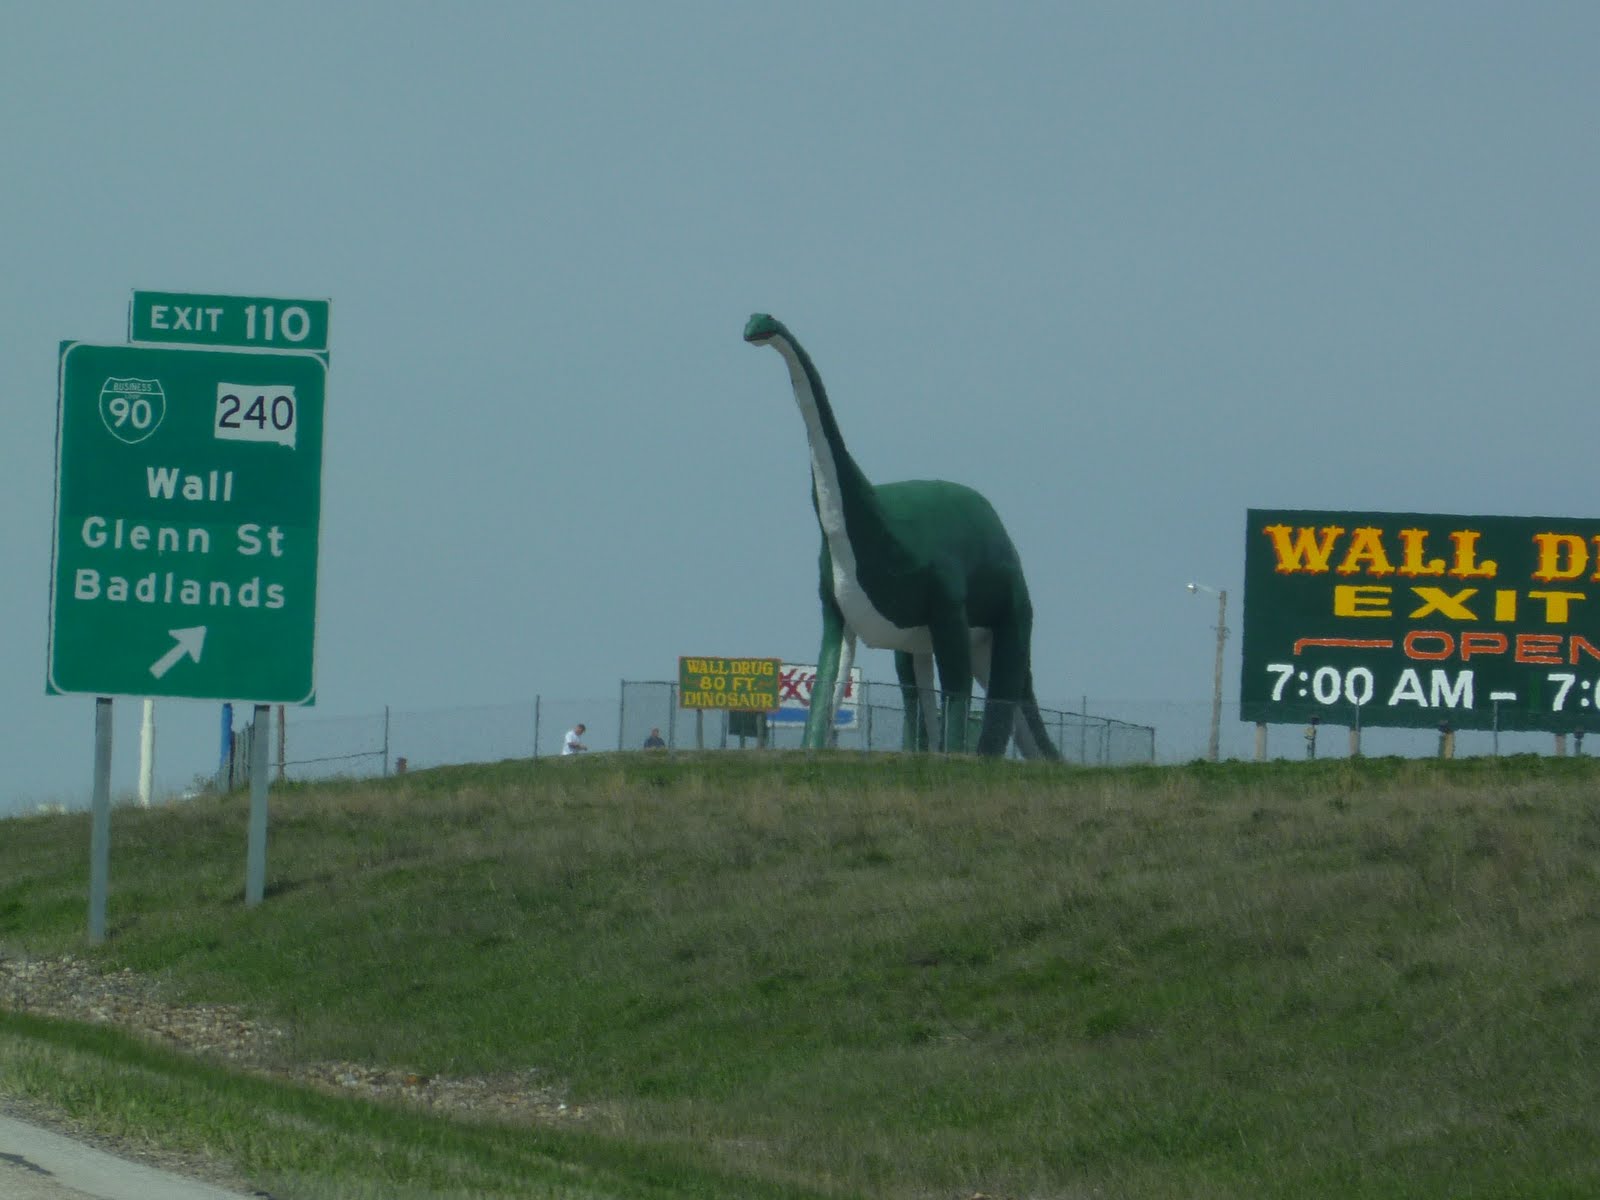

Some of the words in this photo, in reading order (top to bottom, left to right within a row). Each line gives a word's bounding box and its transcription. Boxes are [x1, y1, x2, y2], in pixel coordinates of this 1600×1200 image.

[151, 305, 223, 332] EXIT
[245, 305, 310, 342] 110
[113, 382, 152, 392] BUSINESS
[109, 398, 152, 429] 90
[218, 394, 294, 430] 240
[147, 467, 233, 501] Wall
[82, 516, 210, 554] Glenn
[237, 523, 284, 557] St
[1263, 524, 1497, 579] WALL
[1531, 532, 1600, 582] D
[74, 569, 285, 609] Badlands
[1334, 585, 1586, 623] EXIT
[687, 659, 729, 674] WALL
[731, 660, 774, 675] DRUG
[700, 676, 726, 690] 80
[732, 677, 758, 691] FT.
[684, 691, 773, 708] DINOSAUR
[1267, 664, 1374, 706] 7:00
[1388, 669, 1474, 710] AM
[1547, 673, 1600, 712] 7:
